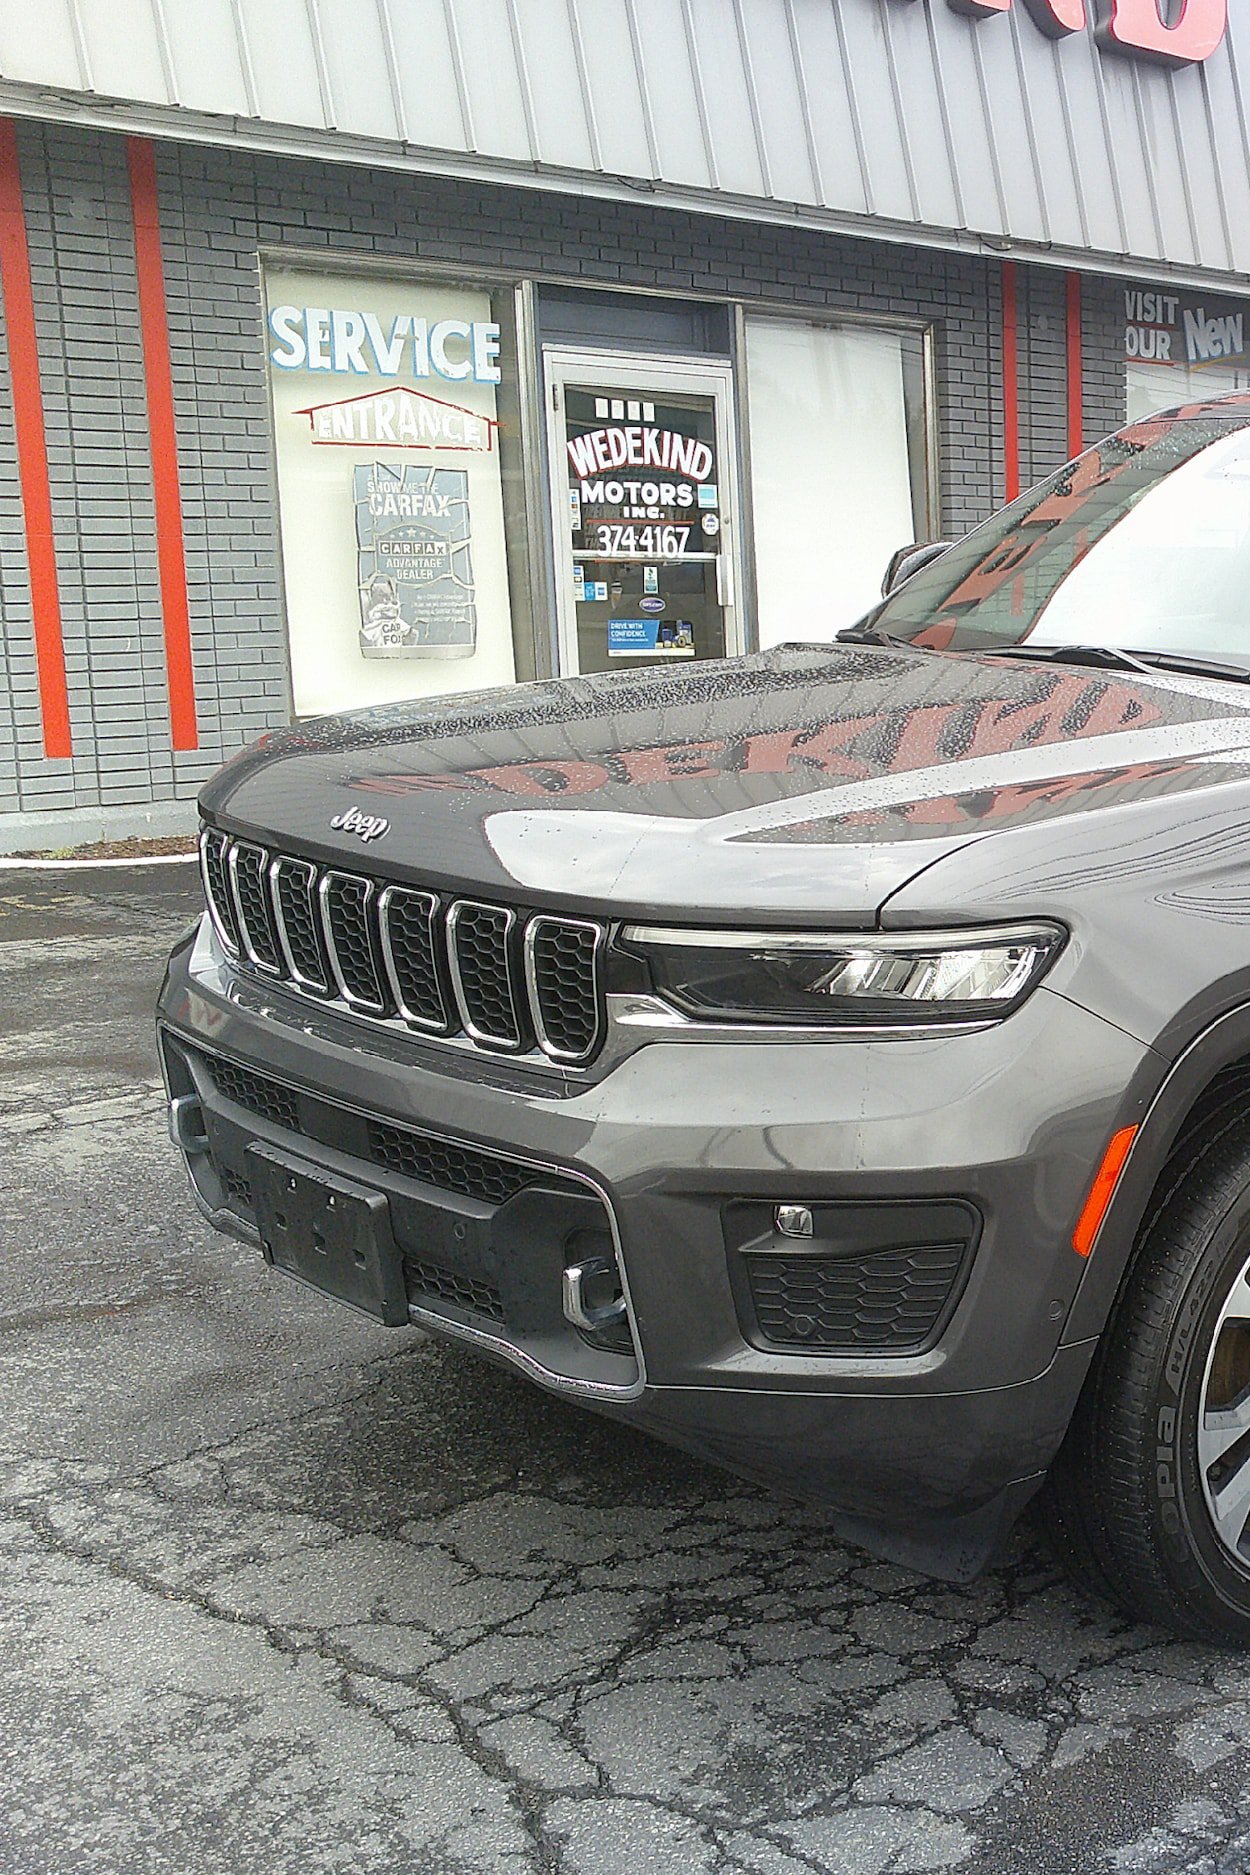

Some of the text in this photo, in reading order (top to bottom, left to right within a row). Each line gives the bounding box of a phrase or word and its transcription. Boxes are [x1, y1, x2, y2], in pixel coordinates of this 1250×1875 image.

[1124, 290, 1179, 324] VISIT
[269, 306, 502, 384] SERVICE
[1125, 326, 1171, 361] OUR
[1184, 307, 1244, 363] New
[318, 395, 482, 444] ENTRANCE
[566, 426, 714, 483] WEDEKIND
[367, 481, 401, 493] SHOW
[581, 480, 694, 507] MOTORS
[368, 494, 451, 517] CARFAX
[623, 506, 665, 519] INC.
[380, 541, 447, 555] CARFAX
[597, 525, 690, 559] 374-4167
[386, 558, 443, 568] ADVANTAGE
[397, 568, 434, 580] DEALER
[611, 630, 646, 638] CONFIDENCE
[330, 805, 391, 844] Jeep
